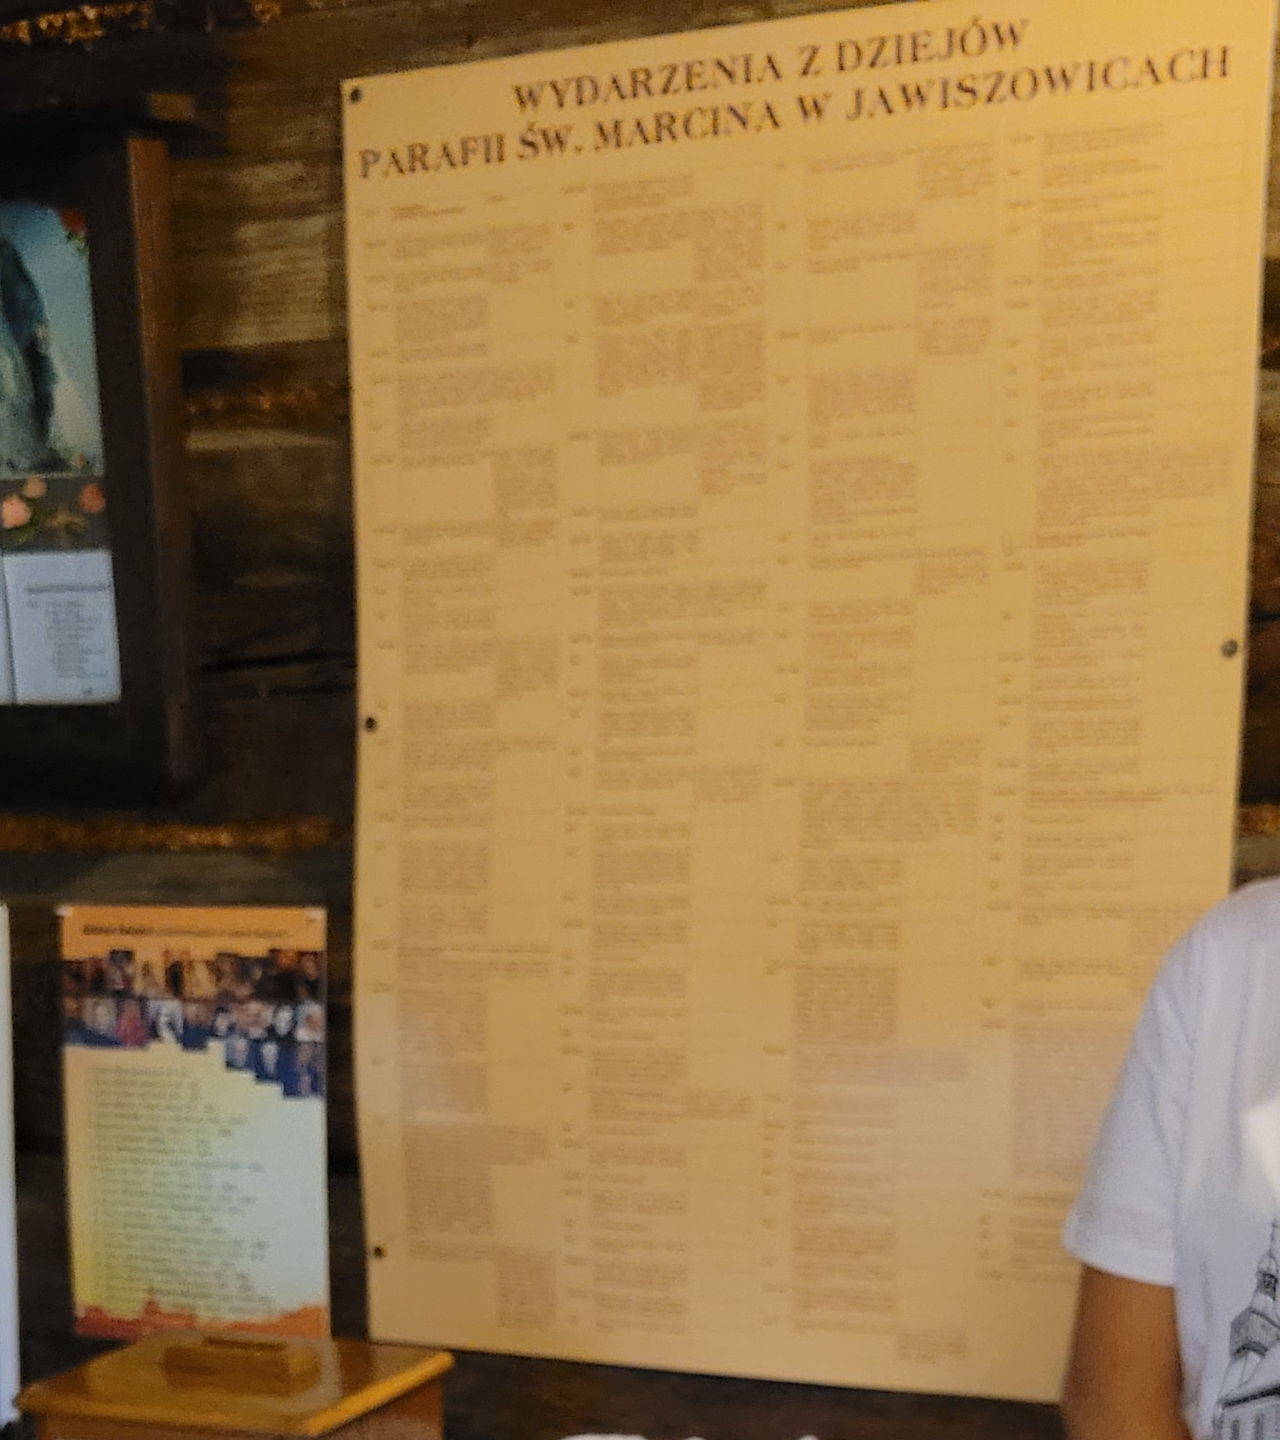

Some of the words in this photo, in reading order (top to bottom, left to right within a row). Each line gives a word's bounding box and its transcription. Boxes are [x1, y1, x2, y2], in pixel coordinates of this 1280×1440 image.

[358, 133, 506, 180] PARAFII
[516, 121, 582, 161] ŚW.
[593, 98, 781, 151] MARCINA
[796, 89, 832, 125] W
[846, 44, 1231, 121] JAWISZOWICACH
[512, 52, 782, 114] WYDARZENIA
[798, 45, 821, 77] Z
[836, 15, 1031, 74] DZIEJÓW
